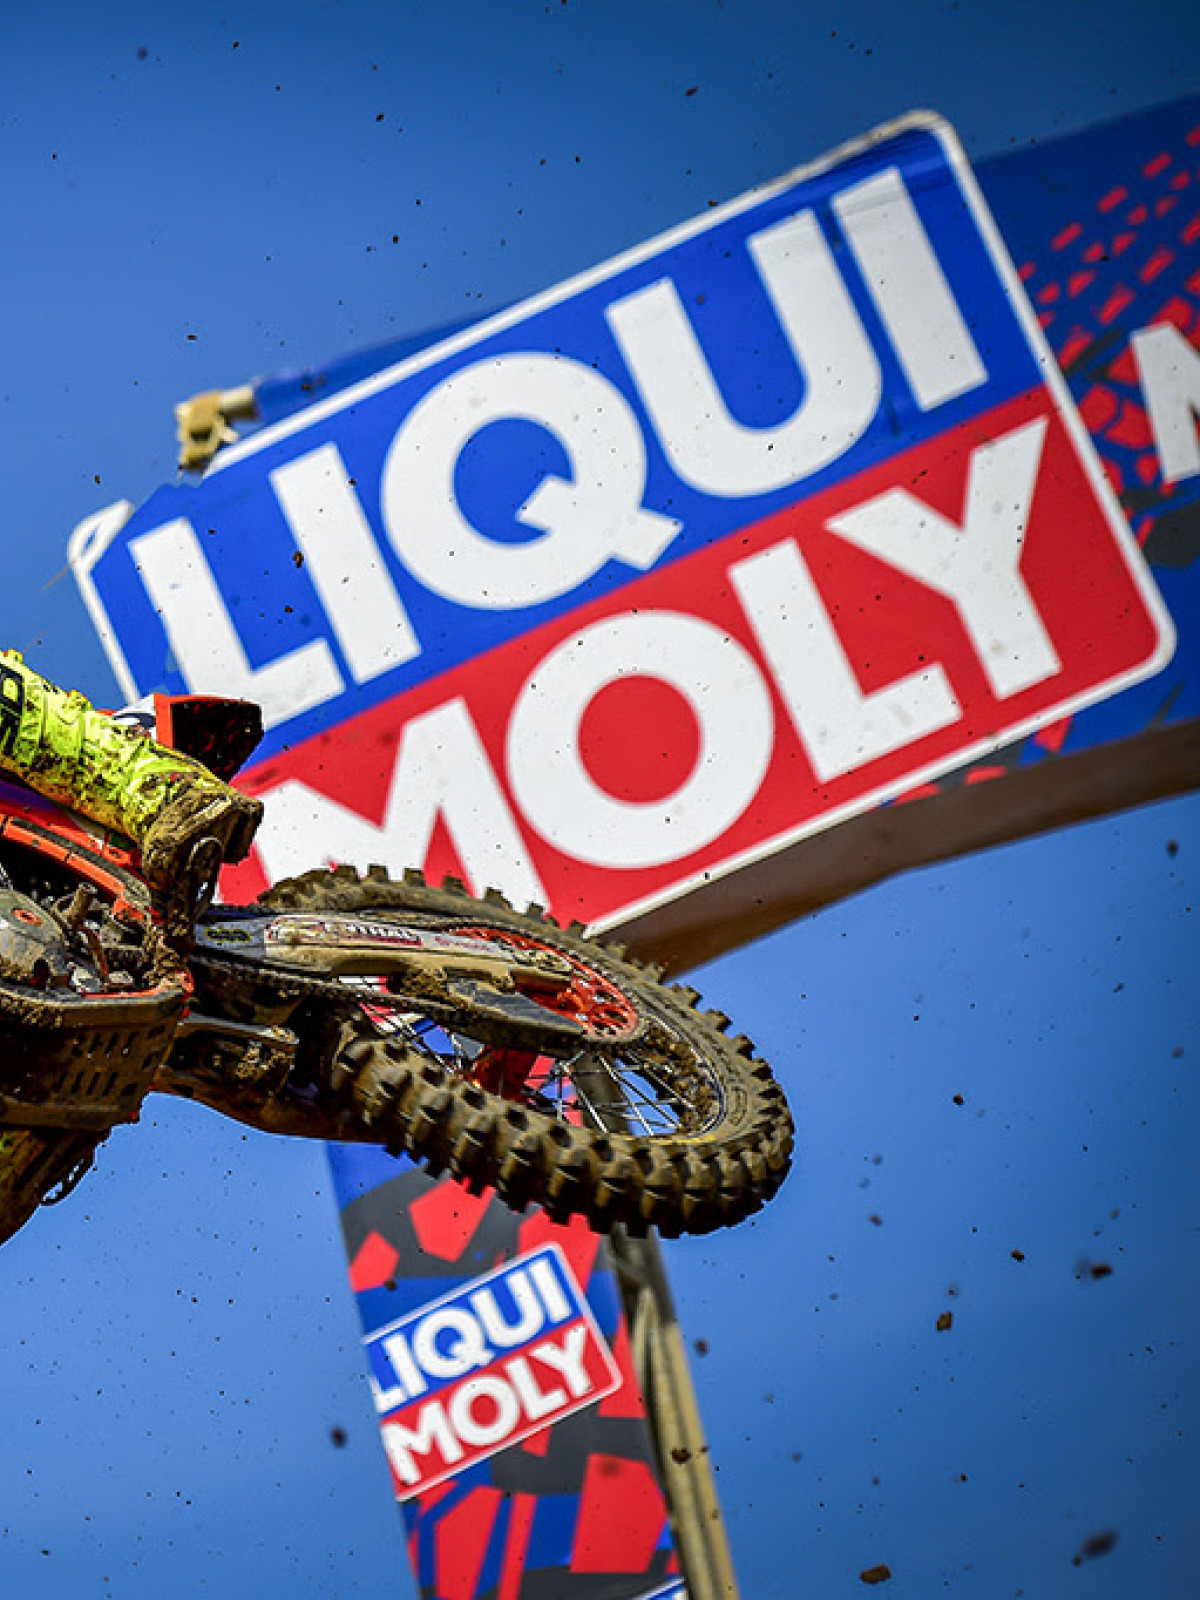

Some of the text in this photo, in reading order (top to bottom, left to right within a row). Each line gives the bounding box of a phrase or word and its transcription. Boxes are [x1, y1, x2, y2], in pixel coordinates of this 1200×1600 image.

[128, 166, 988, 735] LIQUI
[252, 417, 1062, 914] MOLY
[380, 1322, 593, 1485] MOLY
